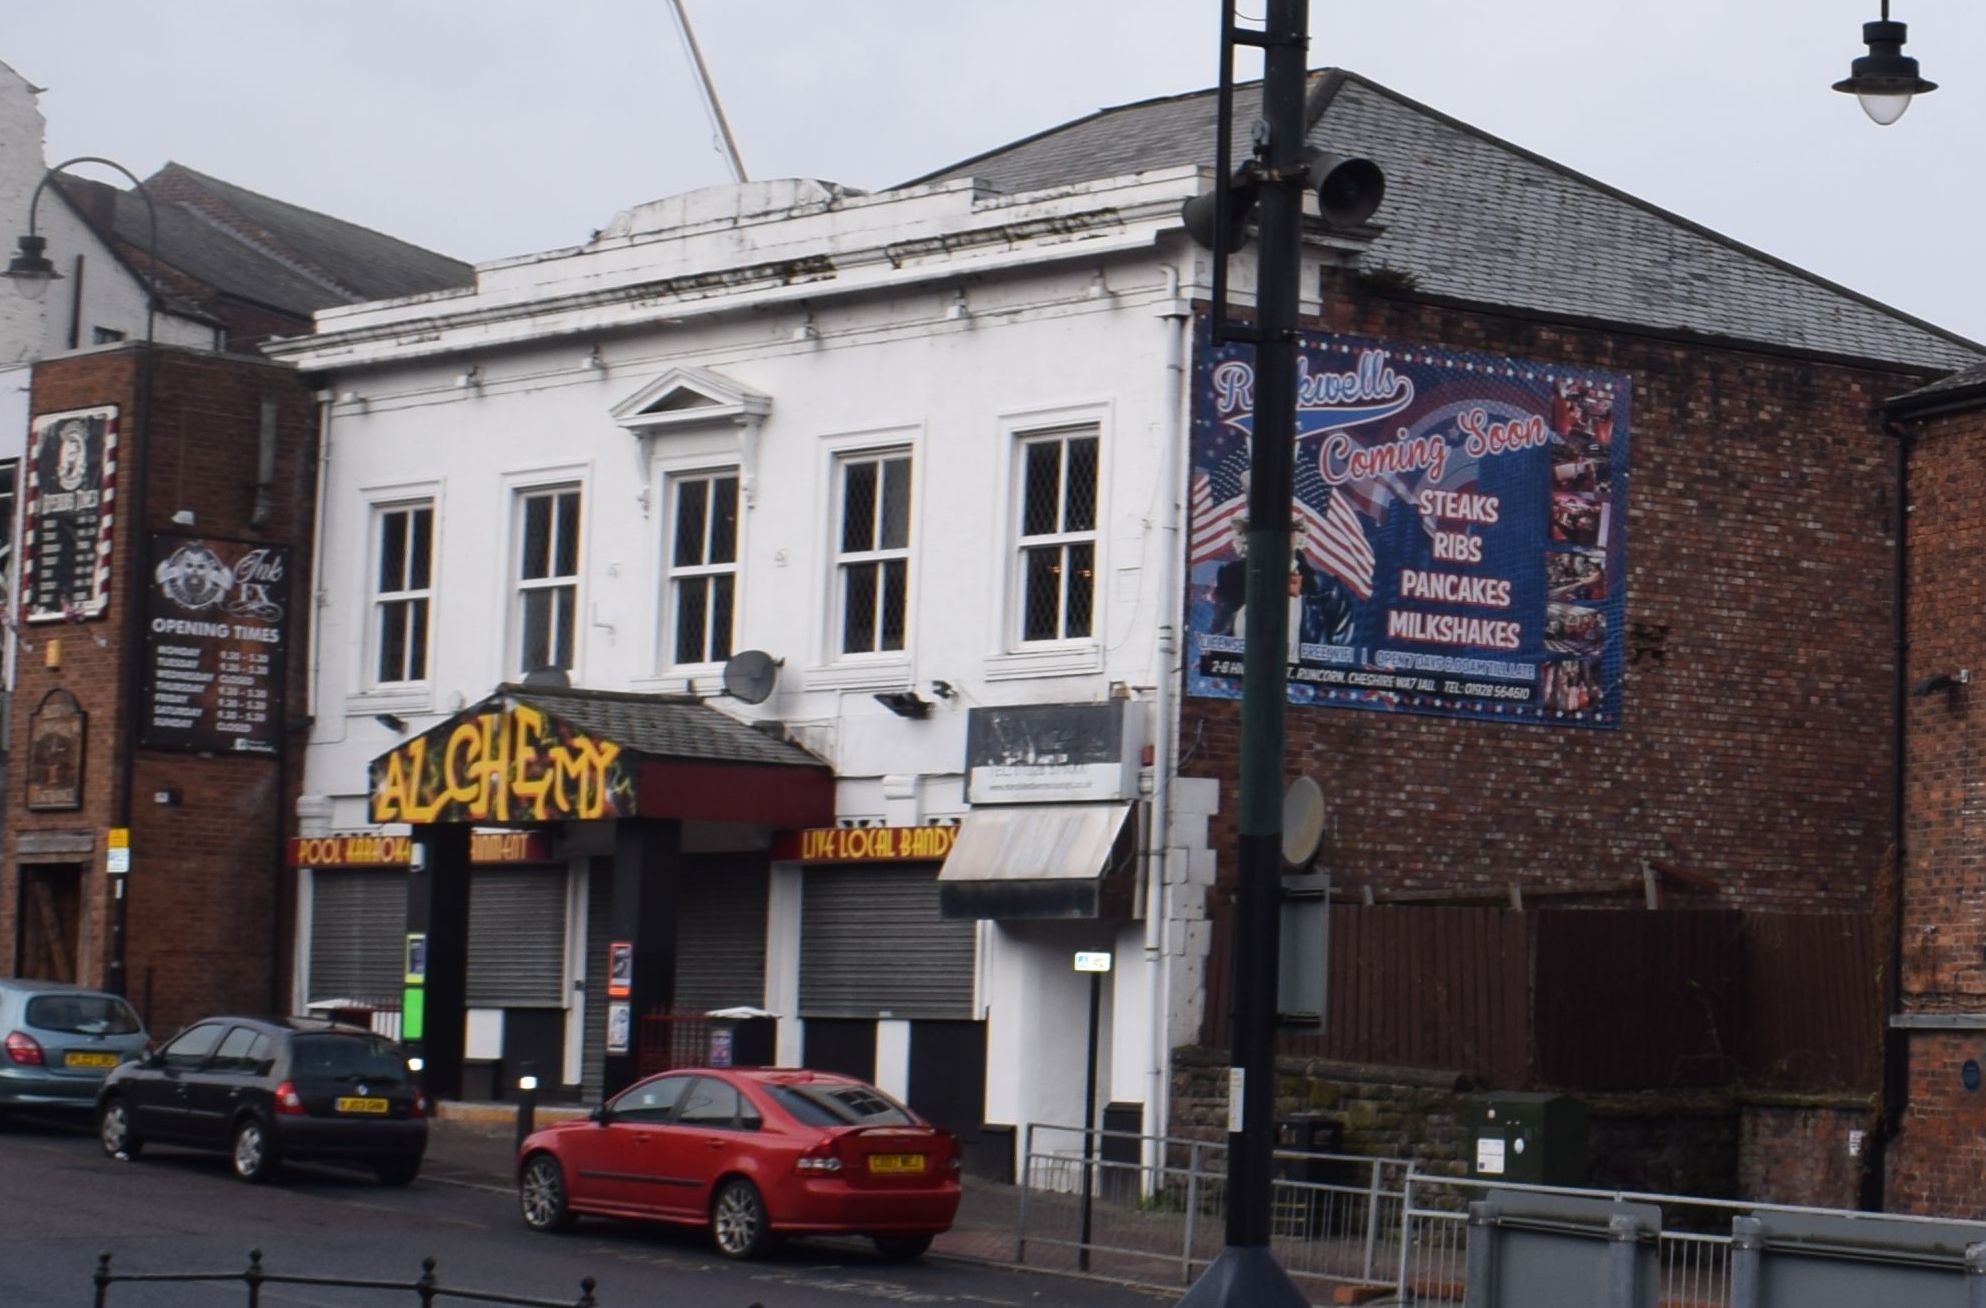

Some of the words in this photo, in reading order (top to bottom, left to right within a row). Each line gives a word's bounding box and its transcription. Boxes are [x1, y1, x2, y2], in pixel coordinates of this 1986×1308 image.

[1213, 349, 1400, 413] Rkwells
[1319, 427, 1449, 486] Coming
[1458, 407, 1548, 458] Soon
[1419, 488, 1499, 523] STEAKS
[1432, 531, 1483, 563] RIBS
[1401, 568, 1512, 607] PANCAKES
[152, 617, 230, 638] OPENING
[233, 624, 280, 643] TIMES
[1388, 610, 1521, 649] MILKSHAKES
[1348, 671, 1393, 688] CHESHIRE
[1395, 675, 1416, 690] WA7
[1464, 683, 1493, 697] 01928
[374, 703, 621, 821] ALCHEMY
[299, 838, 341, 864] POOL
[803, 828, 837, 859] LIVE
[838, 827, 895, 858] LOCAL
